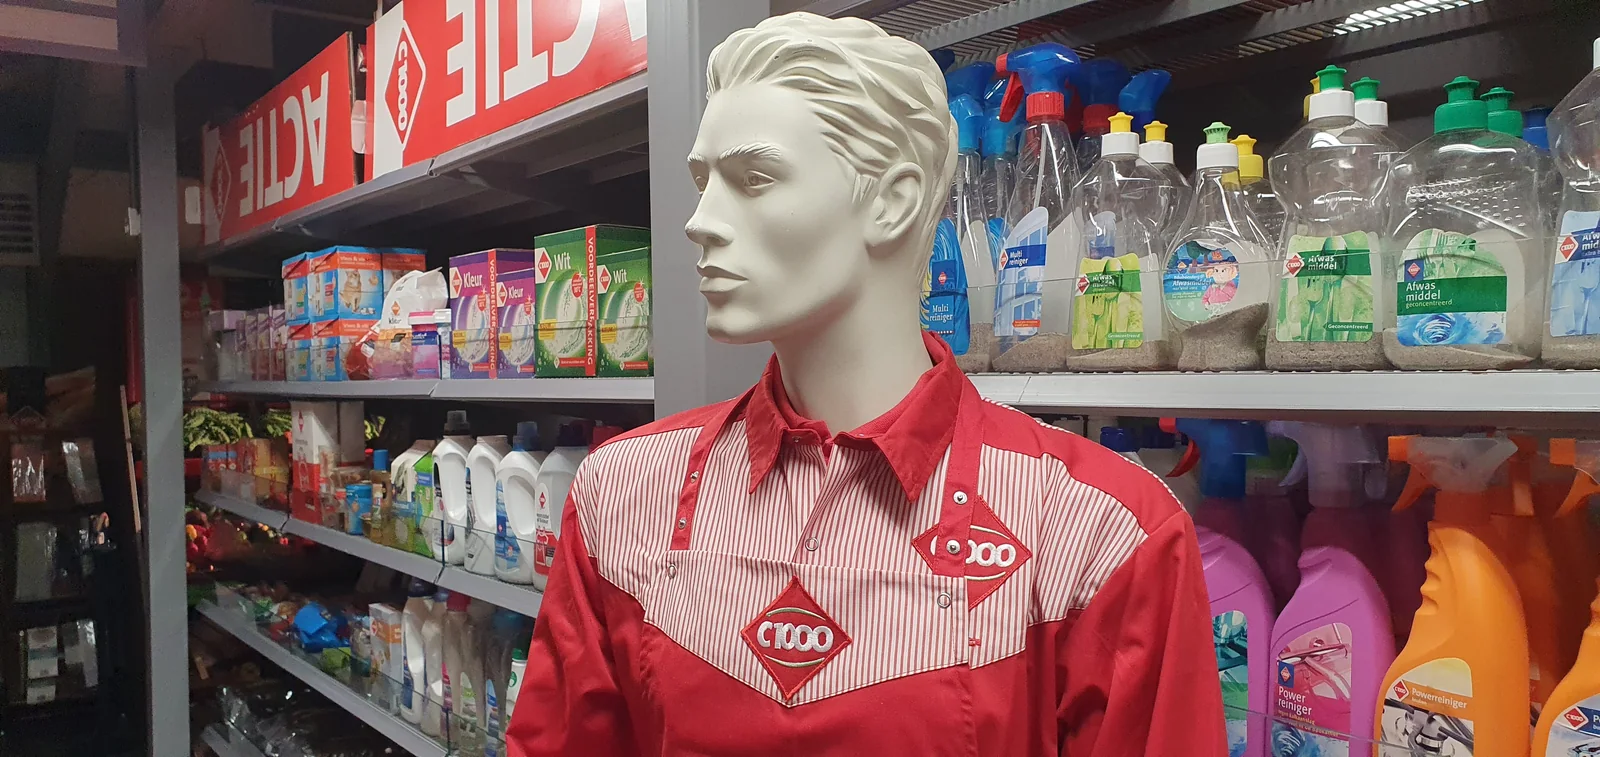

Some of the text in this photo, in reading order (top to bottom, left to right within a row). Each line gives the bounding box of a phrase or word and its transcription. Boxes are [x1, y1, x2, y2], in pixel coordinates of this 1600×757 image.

[398, 41, 408, 131] C1000
[240, 71, 329, 217] ACTIE
[1010, 250, 1023, 258] Multi
[554, 252, 571, 271] Wit
[1008, 258, 1029, 267] reiniger
[463, 273, 482, 288] Kleur
[613, 269, 627, 284] Wit
[508, 287, 524, 298] Kleur
[1405, 281, 1436, 292] Afwas
[1405, 290, 1441, 301] middel
[932, 303, 949, 313] Multi
[1405, 299, 1453, 309] geconcentreerd
[929, 313, 953, 324] reiniger
[757, 621, 834, 652] C1000
[1278, 686, 1306, 703] Power
[1411, 687, 1468, 709] Powerreiniger
[1278, 697, 1312, 716] reiniger
[1565, 713, 1584, 722] C1000
